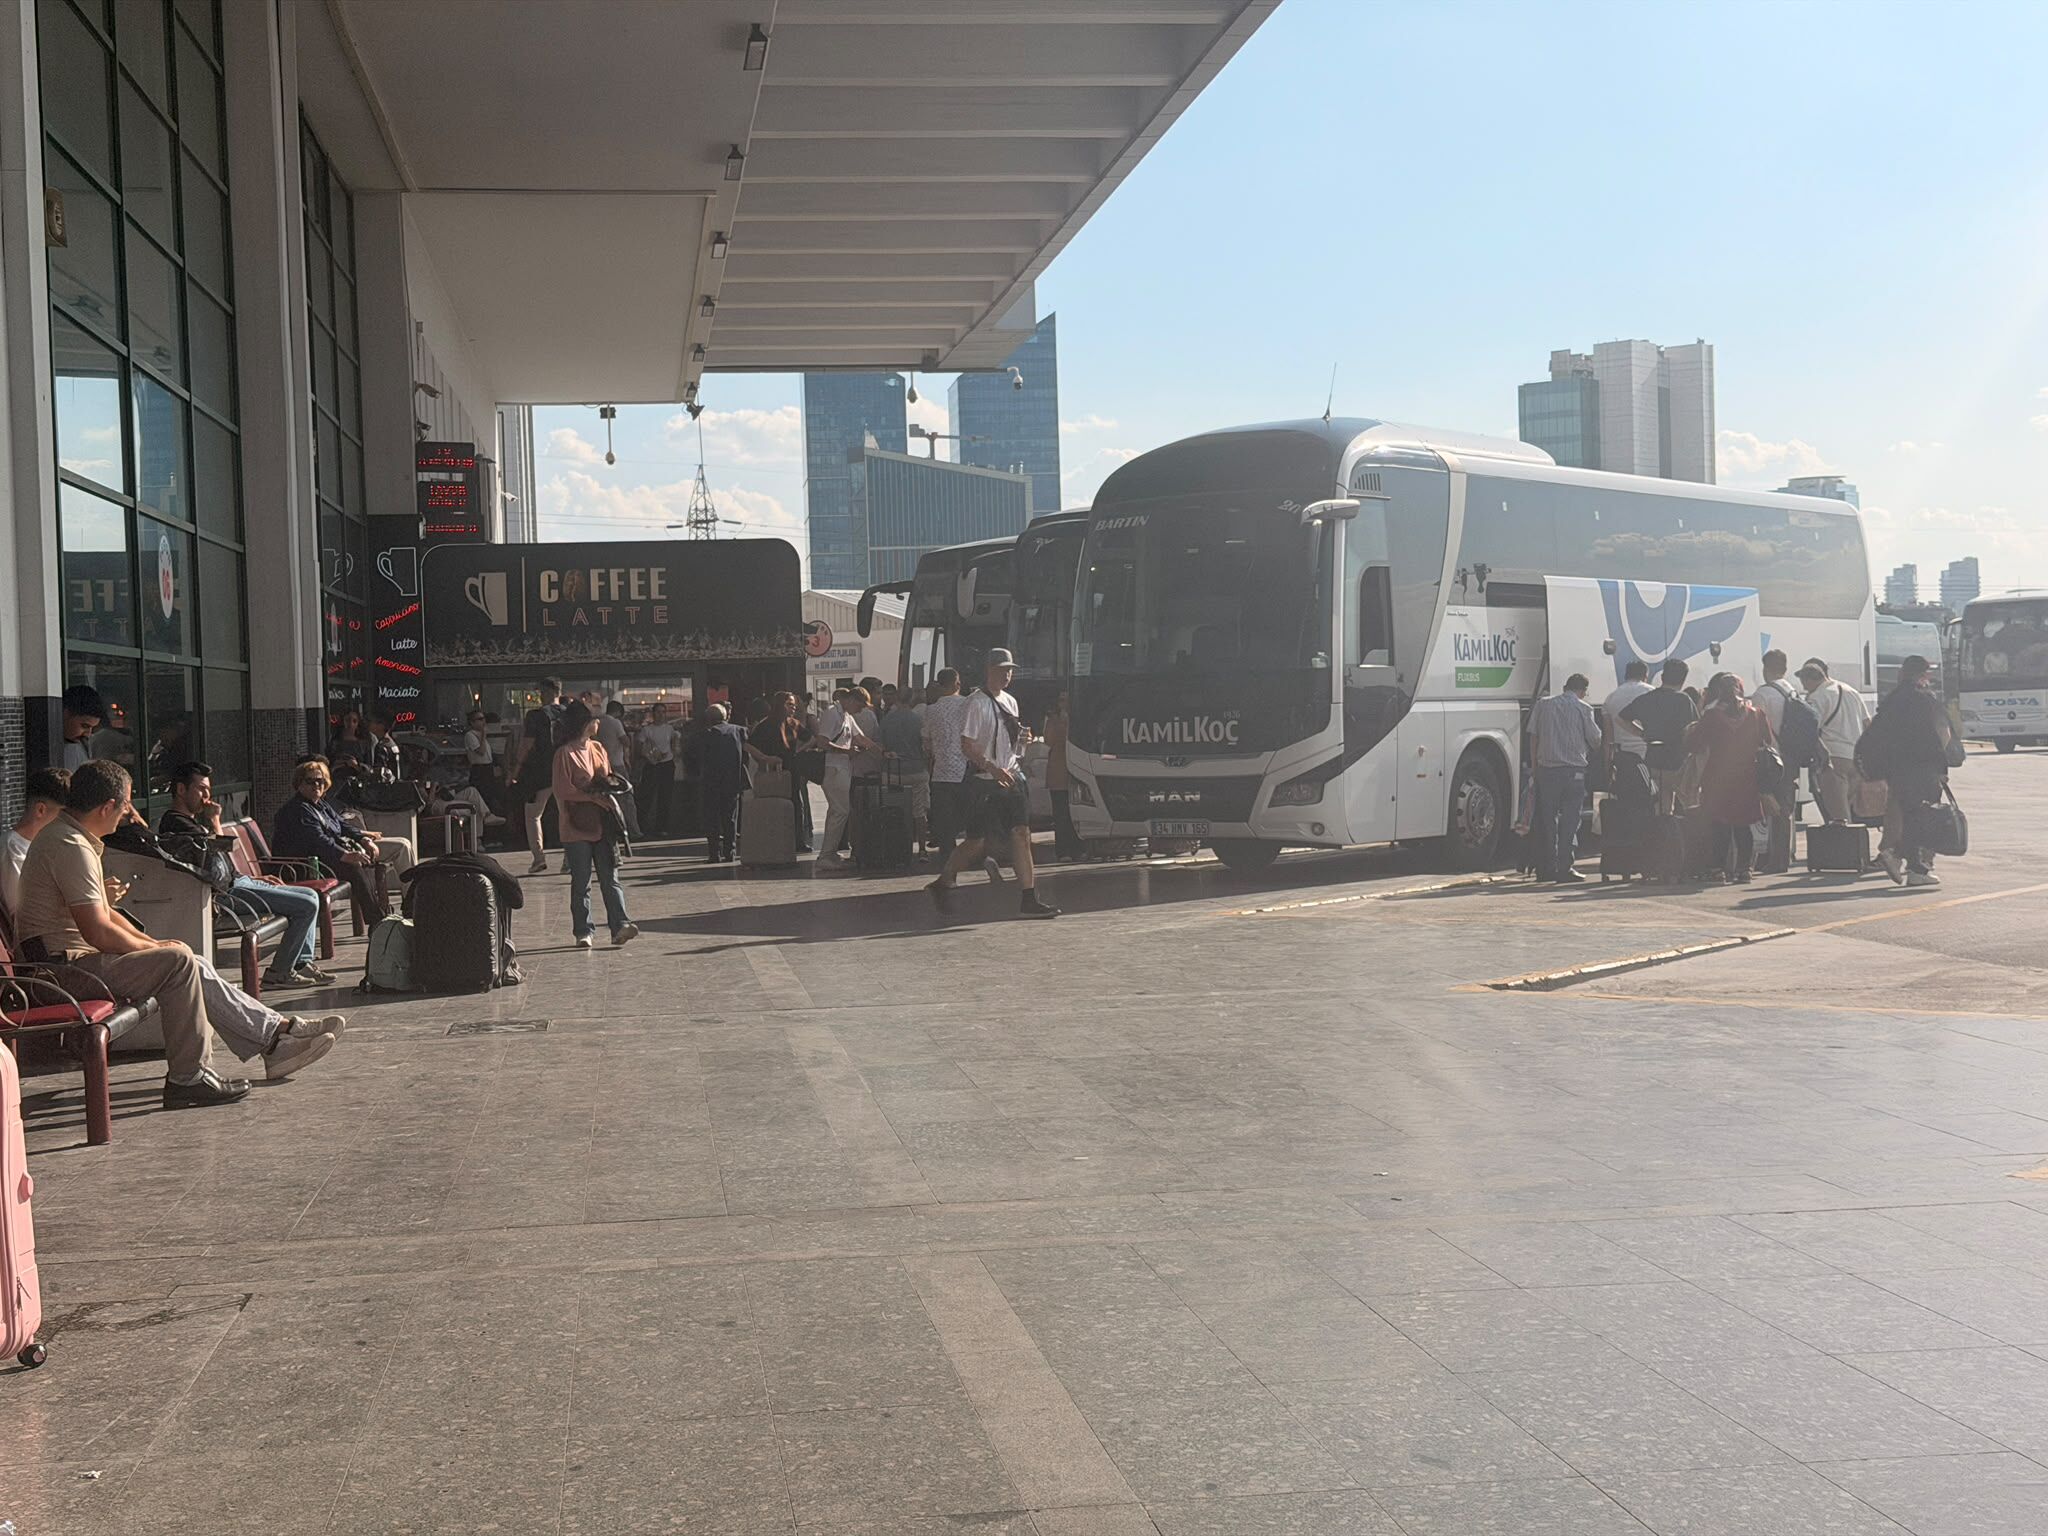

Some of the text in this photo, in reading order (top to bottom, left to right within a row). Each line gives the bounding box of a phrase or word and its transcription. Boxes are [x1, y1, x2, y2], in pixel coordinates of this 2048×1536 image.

[1095, 515, 1150, 531] BARTIN
[540, 567, 668, 603] COFFEE
[542, 605, 669, 627] LATTE
[391, 638, 418, 651] Latte
[378, 686, 421, 699] Maciato
[1983, 697, 2040, 706] TOSYA
[1149, 790, 1201, 802] MAN
[1157, 823, 1169, 834] 34
